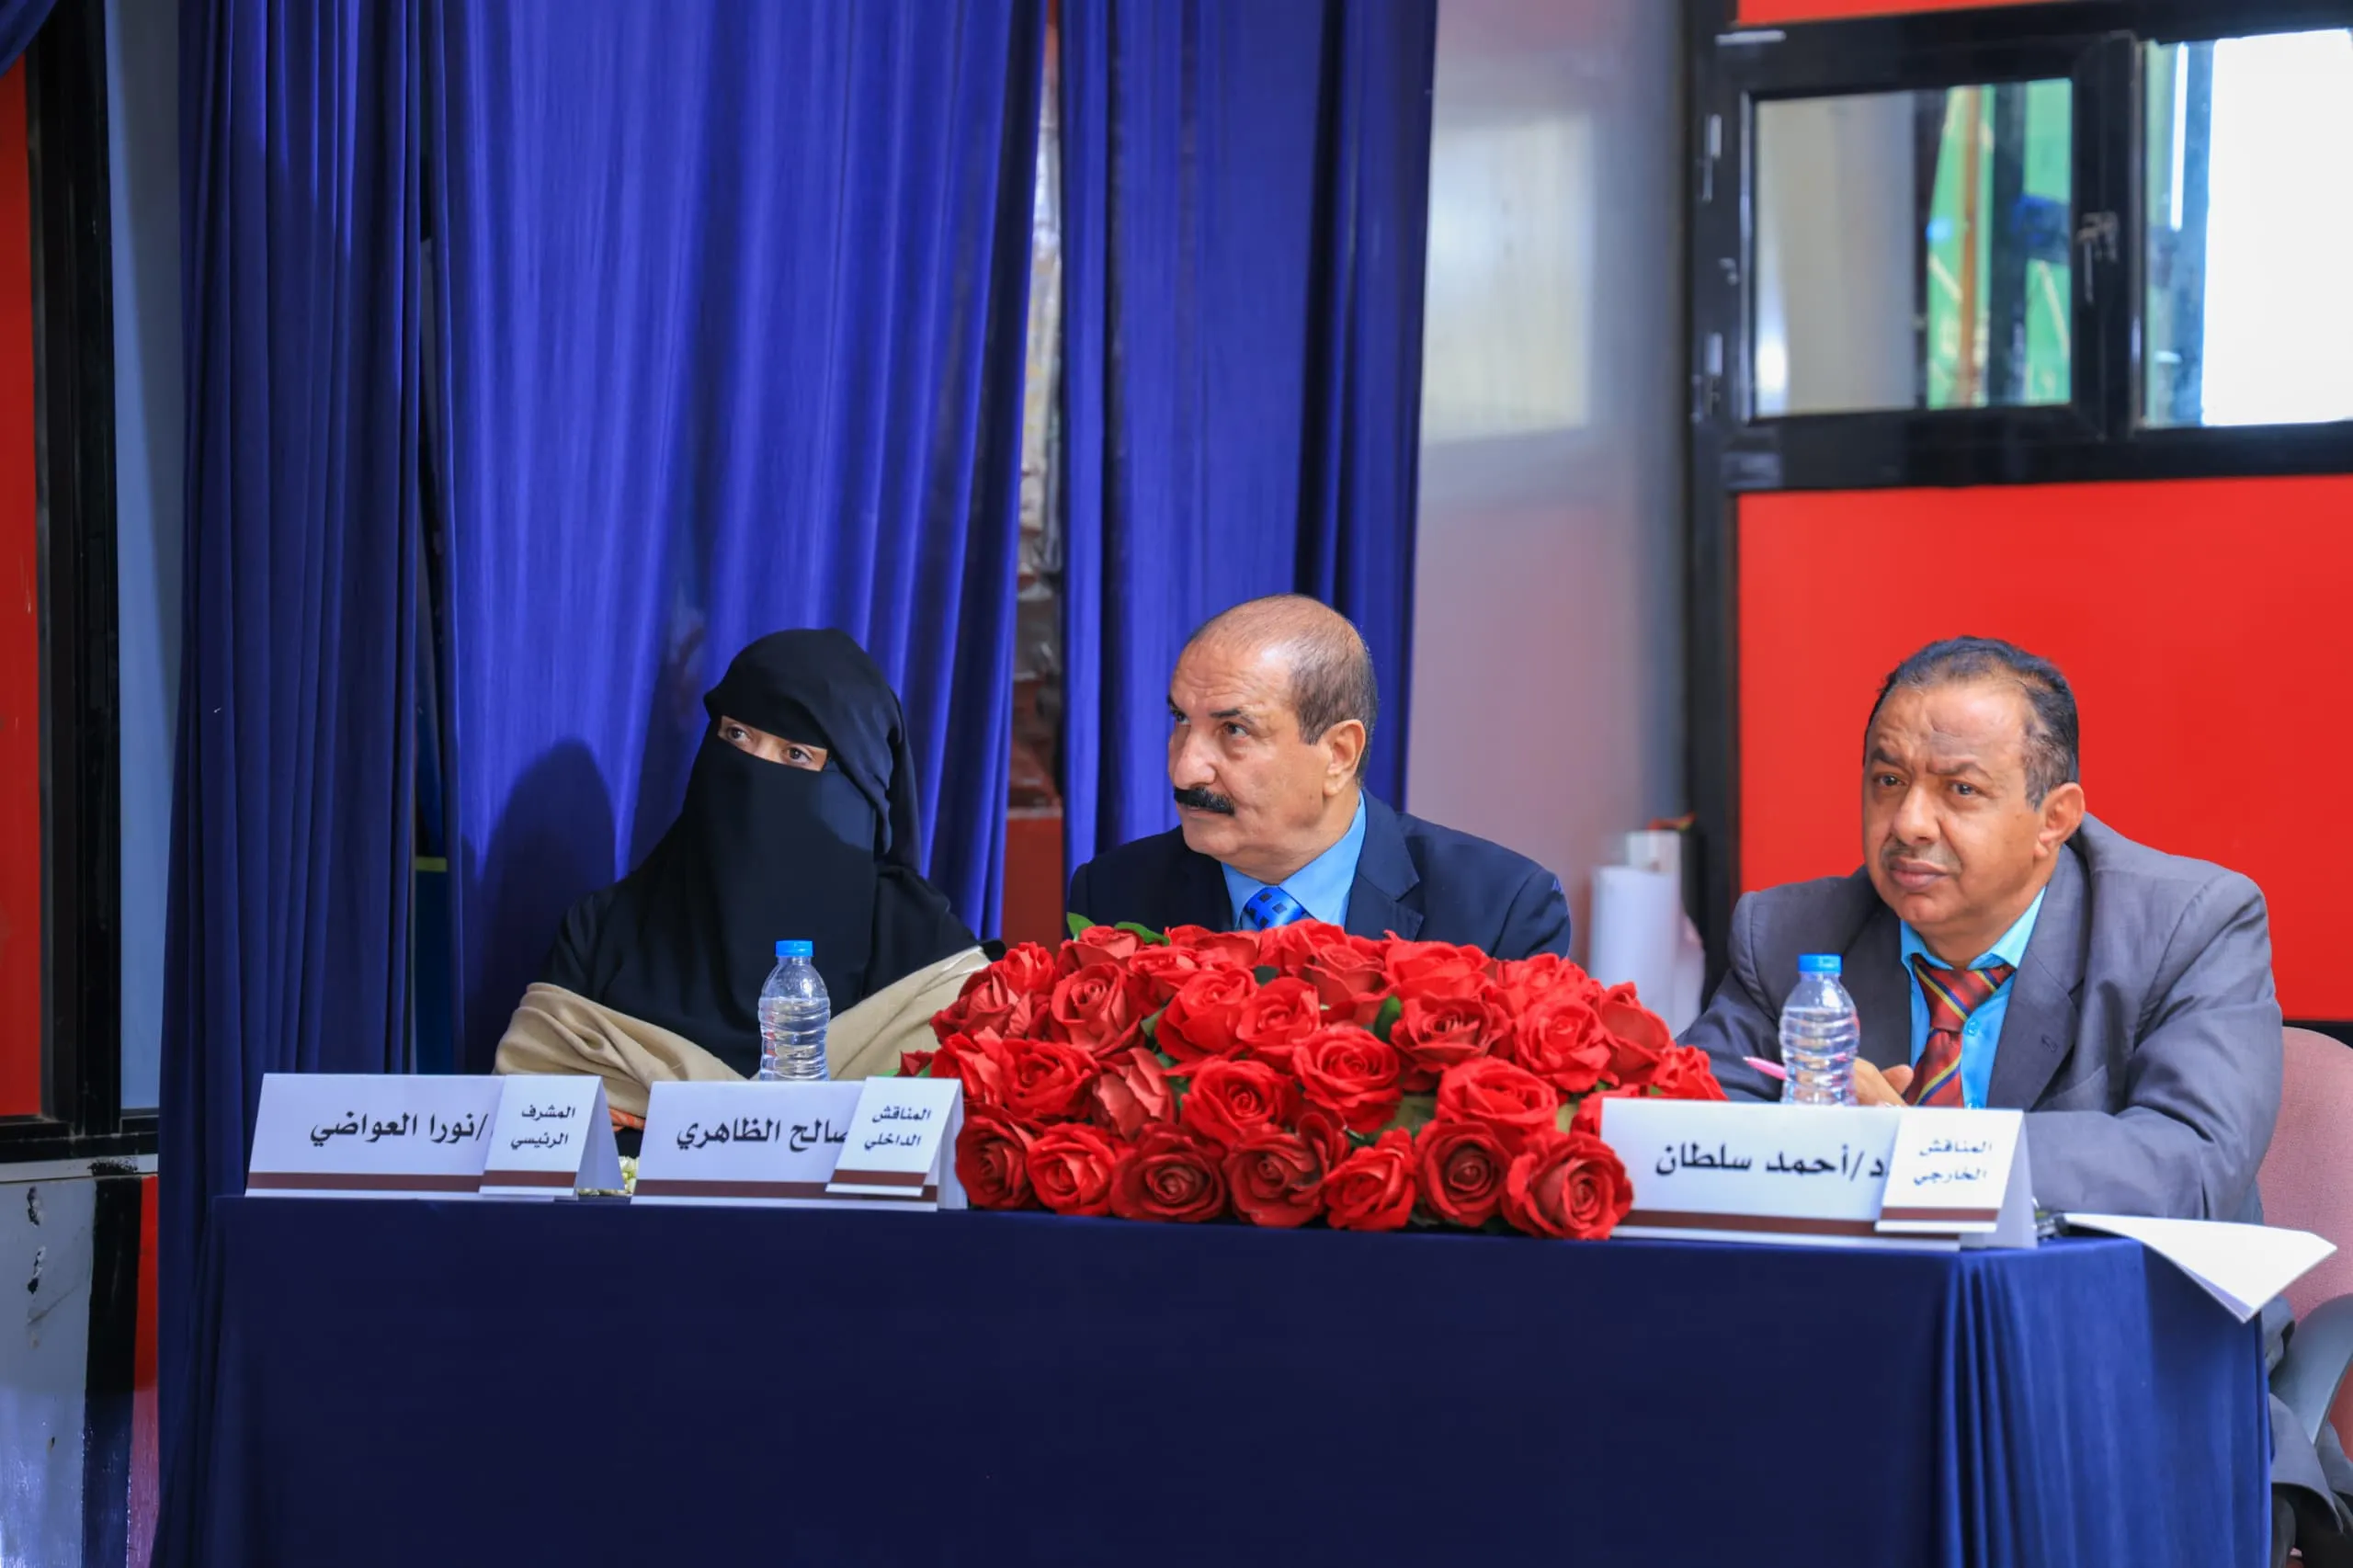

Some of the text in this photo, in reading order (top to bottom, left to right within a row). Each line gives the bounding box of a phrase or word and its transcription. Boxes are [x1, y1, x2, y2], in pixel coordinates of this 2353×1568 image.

[521, 1104, 576, 1122] المشرف
[871, 1105, 932, 1123] المناقش
[309, 1110, 494, 1147] /نورا العواضي
[676, 1117, 781, 1151] الظاهري
[509, 1131, 569, 1151] الرئيسي
[863, 1131, 922, 1151] الداخلي
[1919, 1139, 1993, 1157] المناقش
[1654, 1142, 1753, 1176] سلطان
[1913, 1167, 1987, 1187] الخارجي
